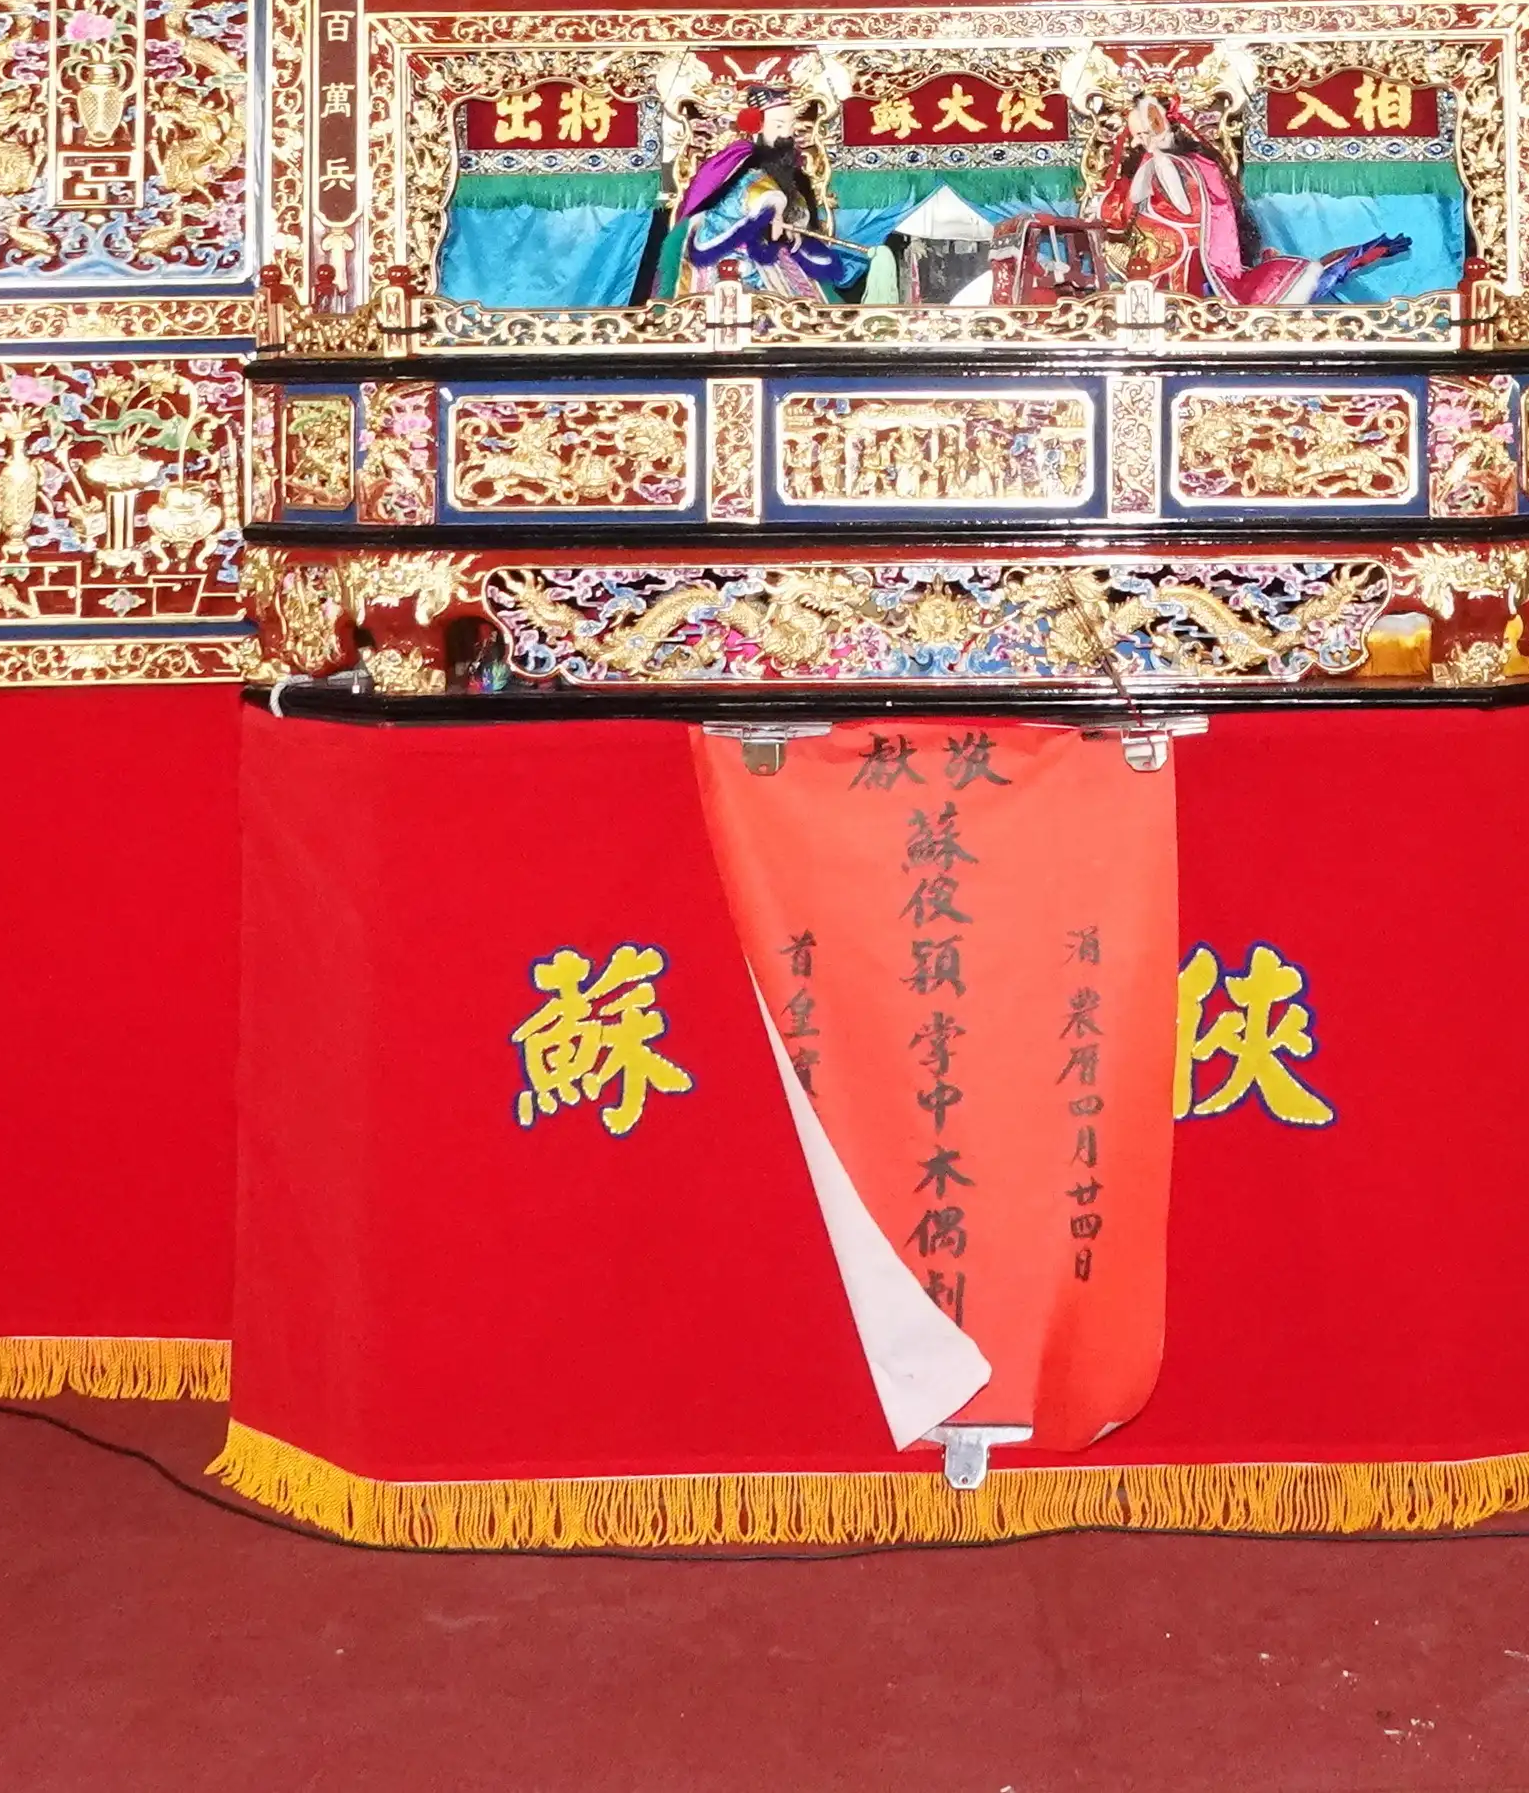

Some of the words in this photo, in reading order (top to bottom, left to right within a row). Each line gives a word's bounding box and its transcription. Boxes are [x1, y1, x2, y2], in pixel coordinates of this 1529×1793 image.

[494, 90, 618, 144] 出將
[870, 82, 1055, 140] 蘇大俠
[1286, 74, 1413, 136] 入相
[512, 944, 694, 1136] 蘇
